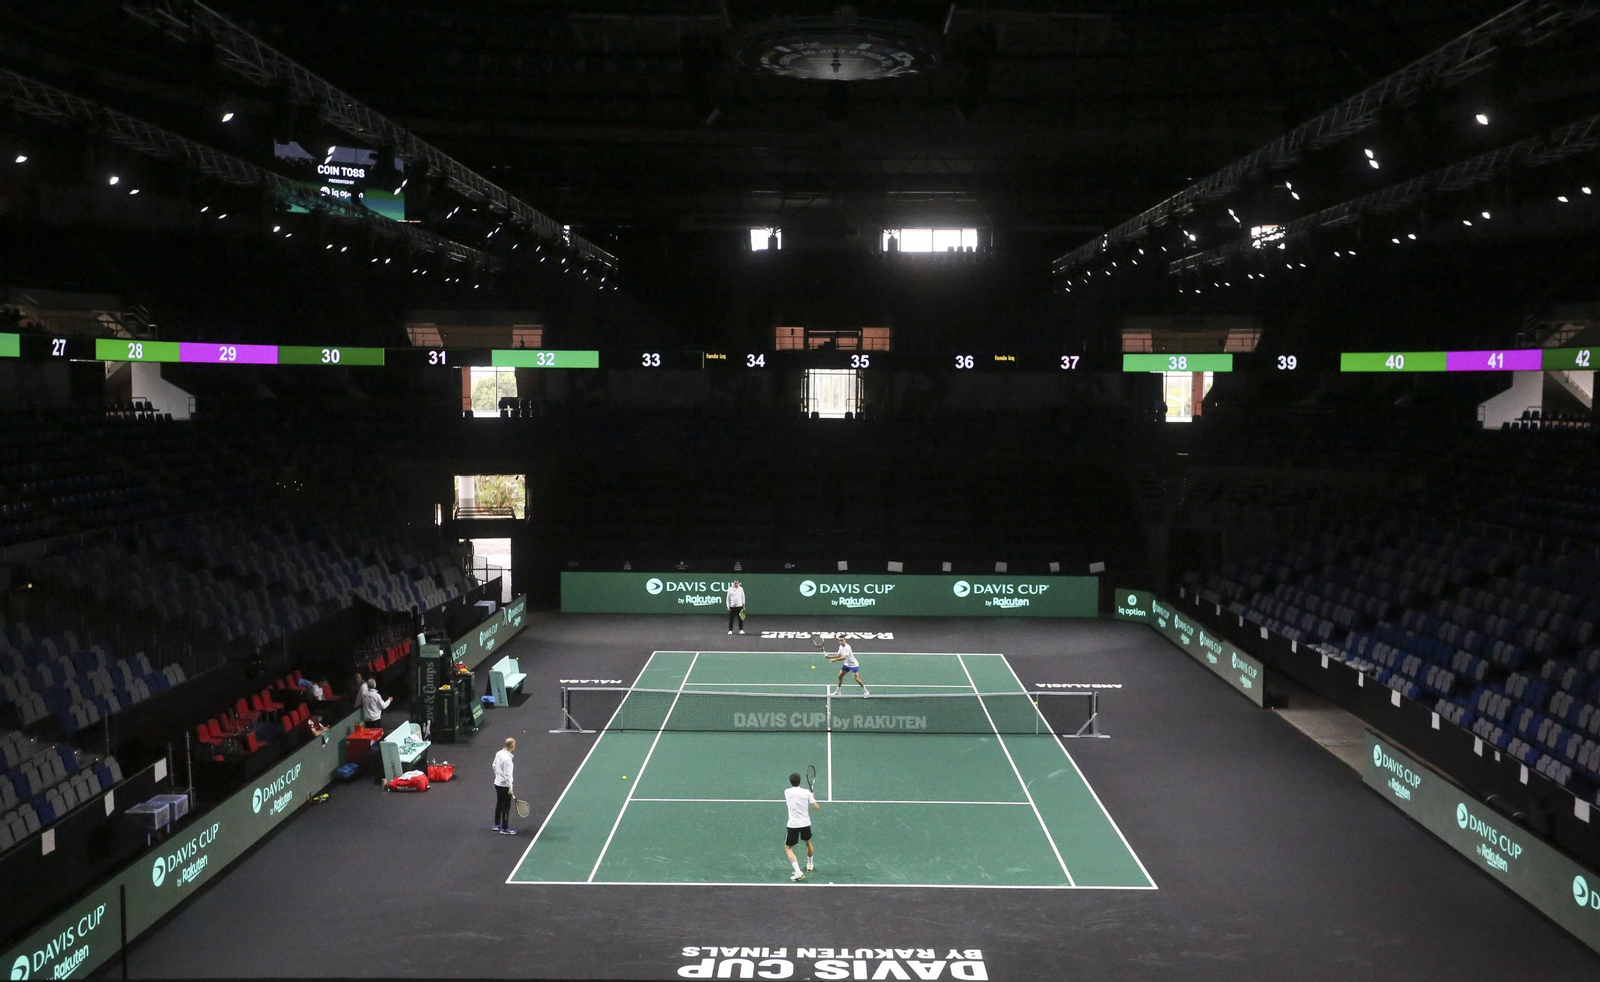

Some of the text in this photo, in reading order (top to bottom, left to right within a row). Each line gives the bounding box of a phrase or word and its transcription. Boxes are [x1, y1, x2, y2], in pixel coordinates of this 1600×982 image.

[317, 164, 365, 178] COIN TOSS
[53, 339, 66, 356] 27
[128, 343, 142, 358] 28
[220, 347, 236, 361] 29
[322, 349, 339, 363] 30
[429, 351, 447, 364] 31
[537, 353, 554, 365] 32
[642, 353, 660, 366] 33
[747, 354, 765, 367] 34
[851, 355, 869, 368] 35
[956, 355, 973, 368] 36
[1061, 356, 1079, 369] 37
[1169, 356, 1187, 369] 38
[1278, 356, 1296, 369] 39
[1386, 355, 1404, 369] 40
[1488, 353, 1503, 368] 41
[1576, 350, 1589, 366] 42
[666, 582, 706, 592] DAVIS
[820, 584, 893, 594] DAVIS CUP
[974, 584, 1047, 594] DAVIS CUP
[686, 595, 722, 605] Rakuten
[839, 597, 876, 607] Rakuten
[993, 597, 1029, 608] Rakuten
[1125, 608, 1146, 617] option
[734, 712, 926, 730] DAVIS CUP by RAKUTEN
[1382, 754, 1420, 788] DAVIS CUP
[264, 764, 300, 802] DAVIS CUP
[1470, 814, 1522, 860] DAVIS CUP
[168, 823, 218, 872] DAVIS CUP
[1482, 843, 1508, 872] Rakuten
[182, 854, 208, 882] Rakuten
[33, 904, 105, 972] DAVIS CUP
[682, 946, 983, 960] BY RAKUTEN FINALS
[54, 944, 89, 980] Rakuten
[677, 958, 988, 980] DAVIS CUP
